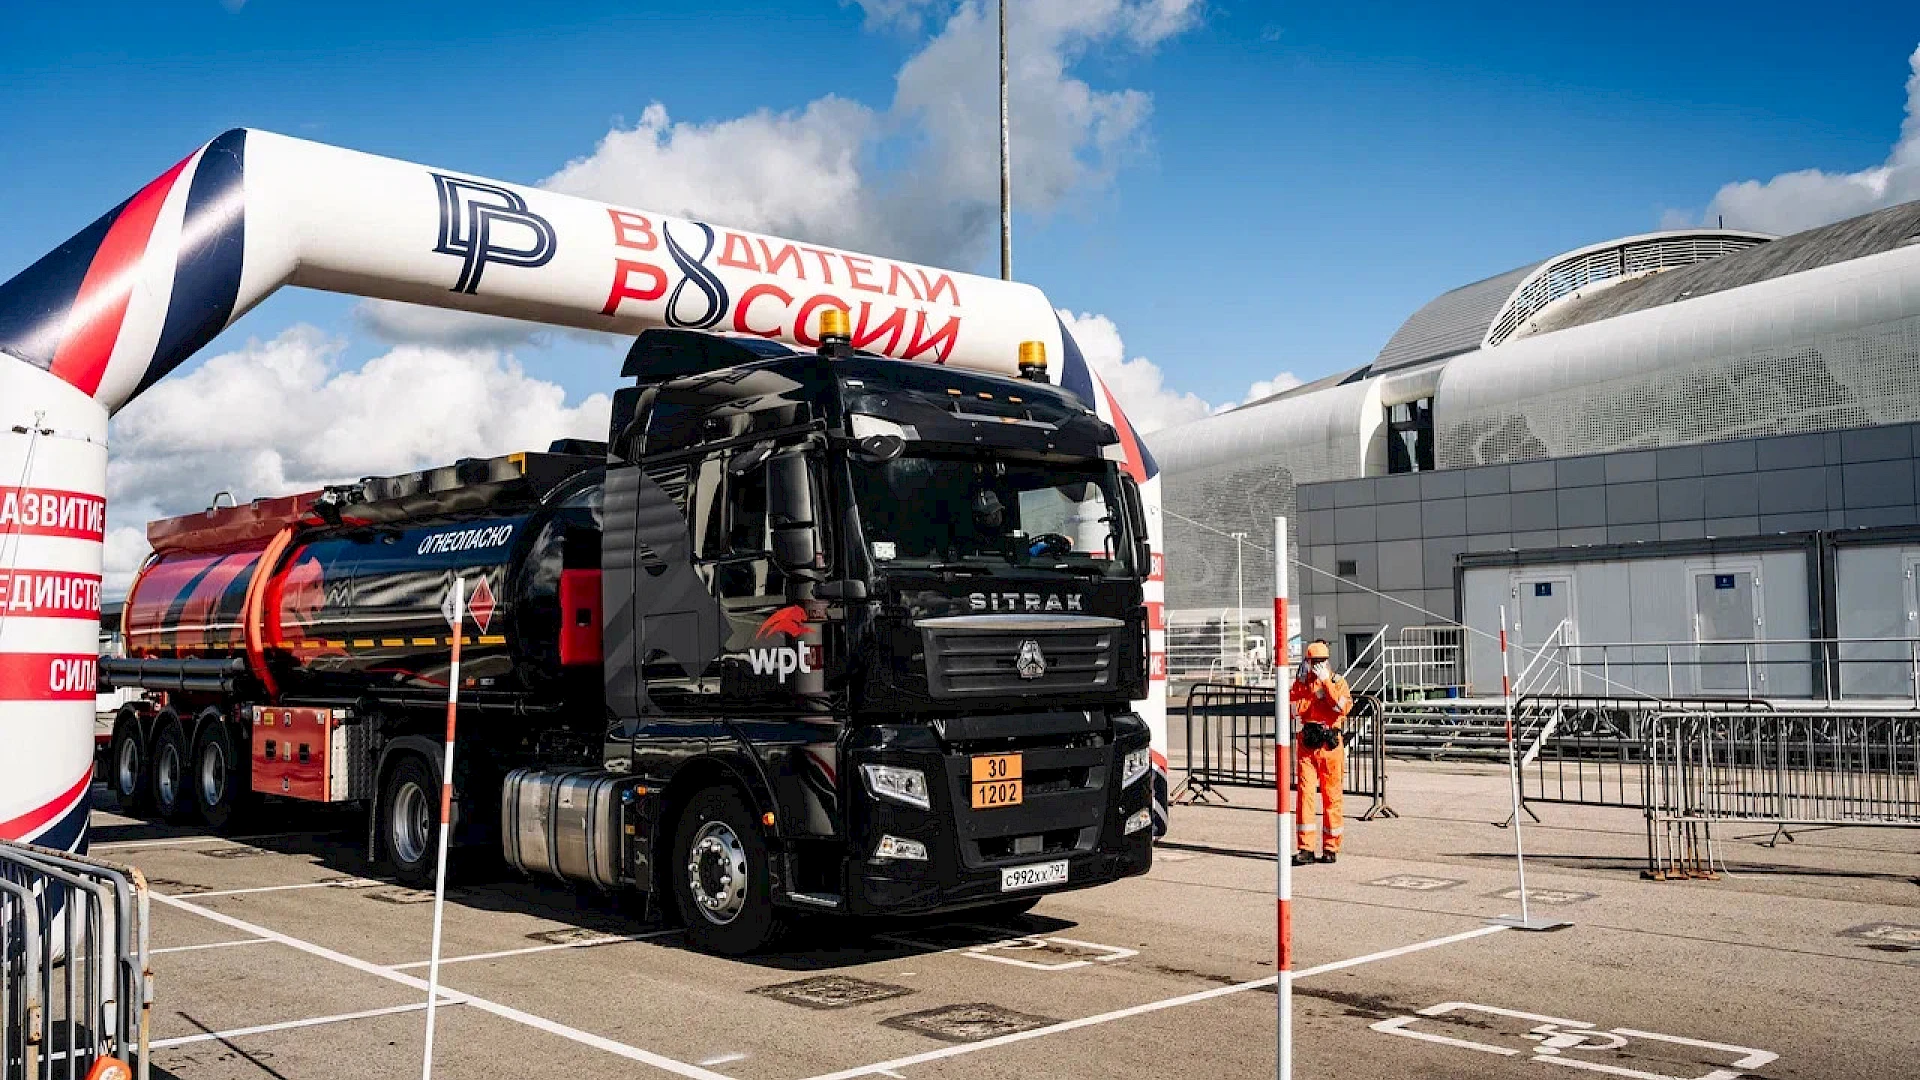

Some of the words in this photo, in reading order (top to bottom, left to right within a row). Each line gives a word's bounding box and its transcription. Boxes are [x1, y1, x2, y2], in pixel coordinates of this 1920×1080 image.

[0, 492, 103, 533] АЗВИТИЕ
[417, 524, 513, 555] ОГНЕОПАСНО
[0, 574, 101, 612] ЕДИНСТВ
[969, 592, 1083, 611] SITRAK
[50, 659, 97, 692] СИЛА
[749, 640, 811, 684] wpt
[988, 758, 1006, 778] 30
[979, 783, 1016, 804] 1202
